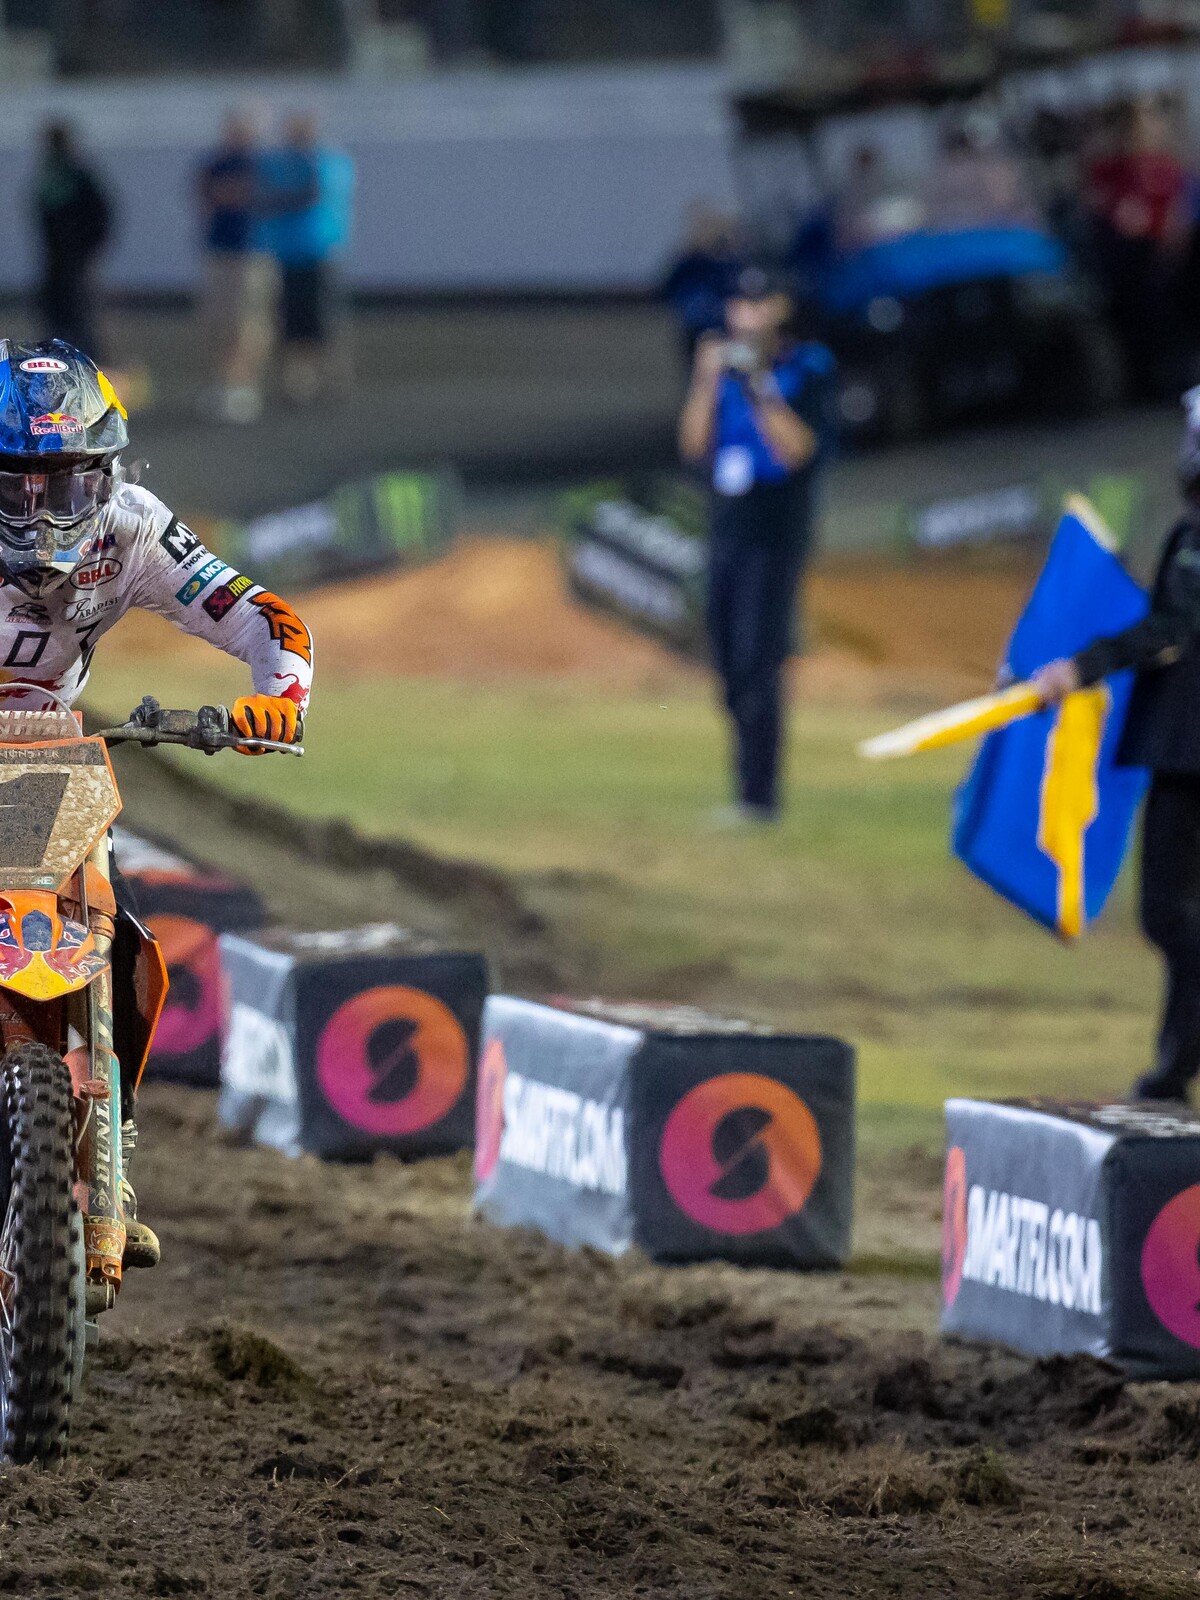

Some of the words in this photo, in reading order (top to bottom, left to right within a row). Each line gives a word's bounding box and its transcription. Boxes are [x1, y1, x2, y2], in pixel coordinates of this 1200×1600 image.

[27, 361, 62, 369] BELL
[30, 424, 59, 436] Red
[60, 424, 84, 434] Bull
[182, 553, 203, 571] THOR
[78, 564, 116, 586] BELL
